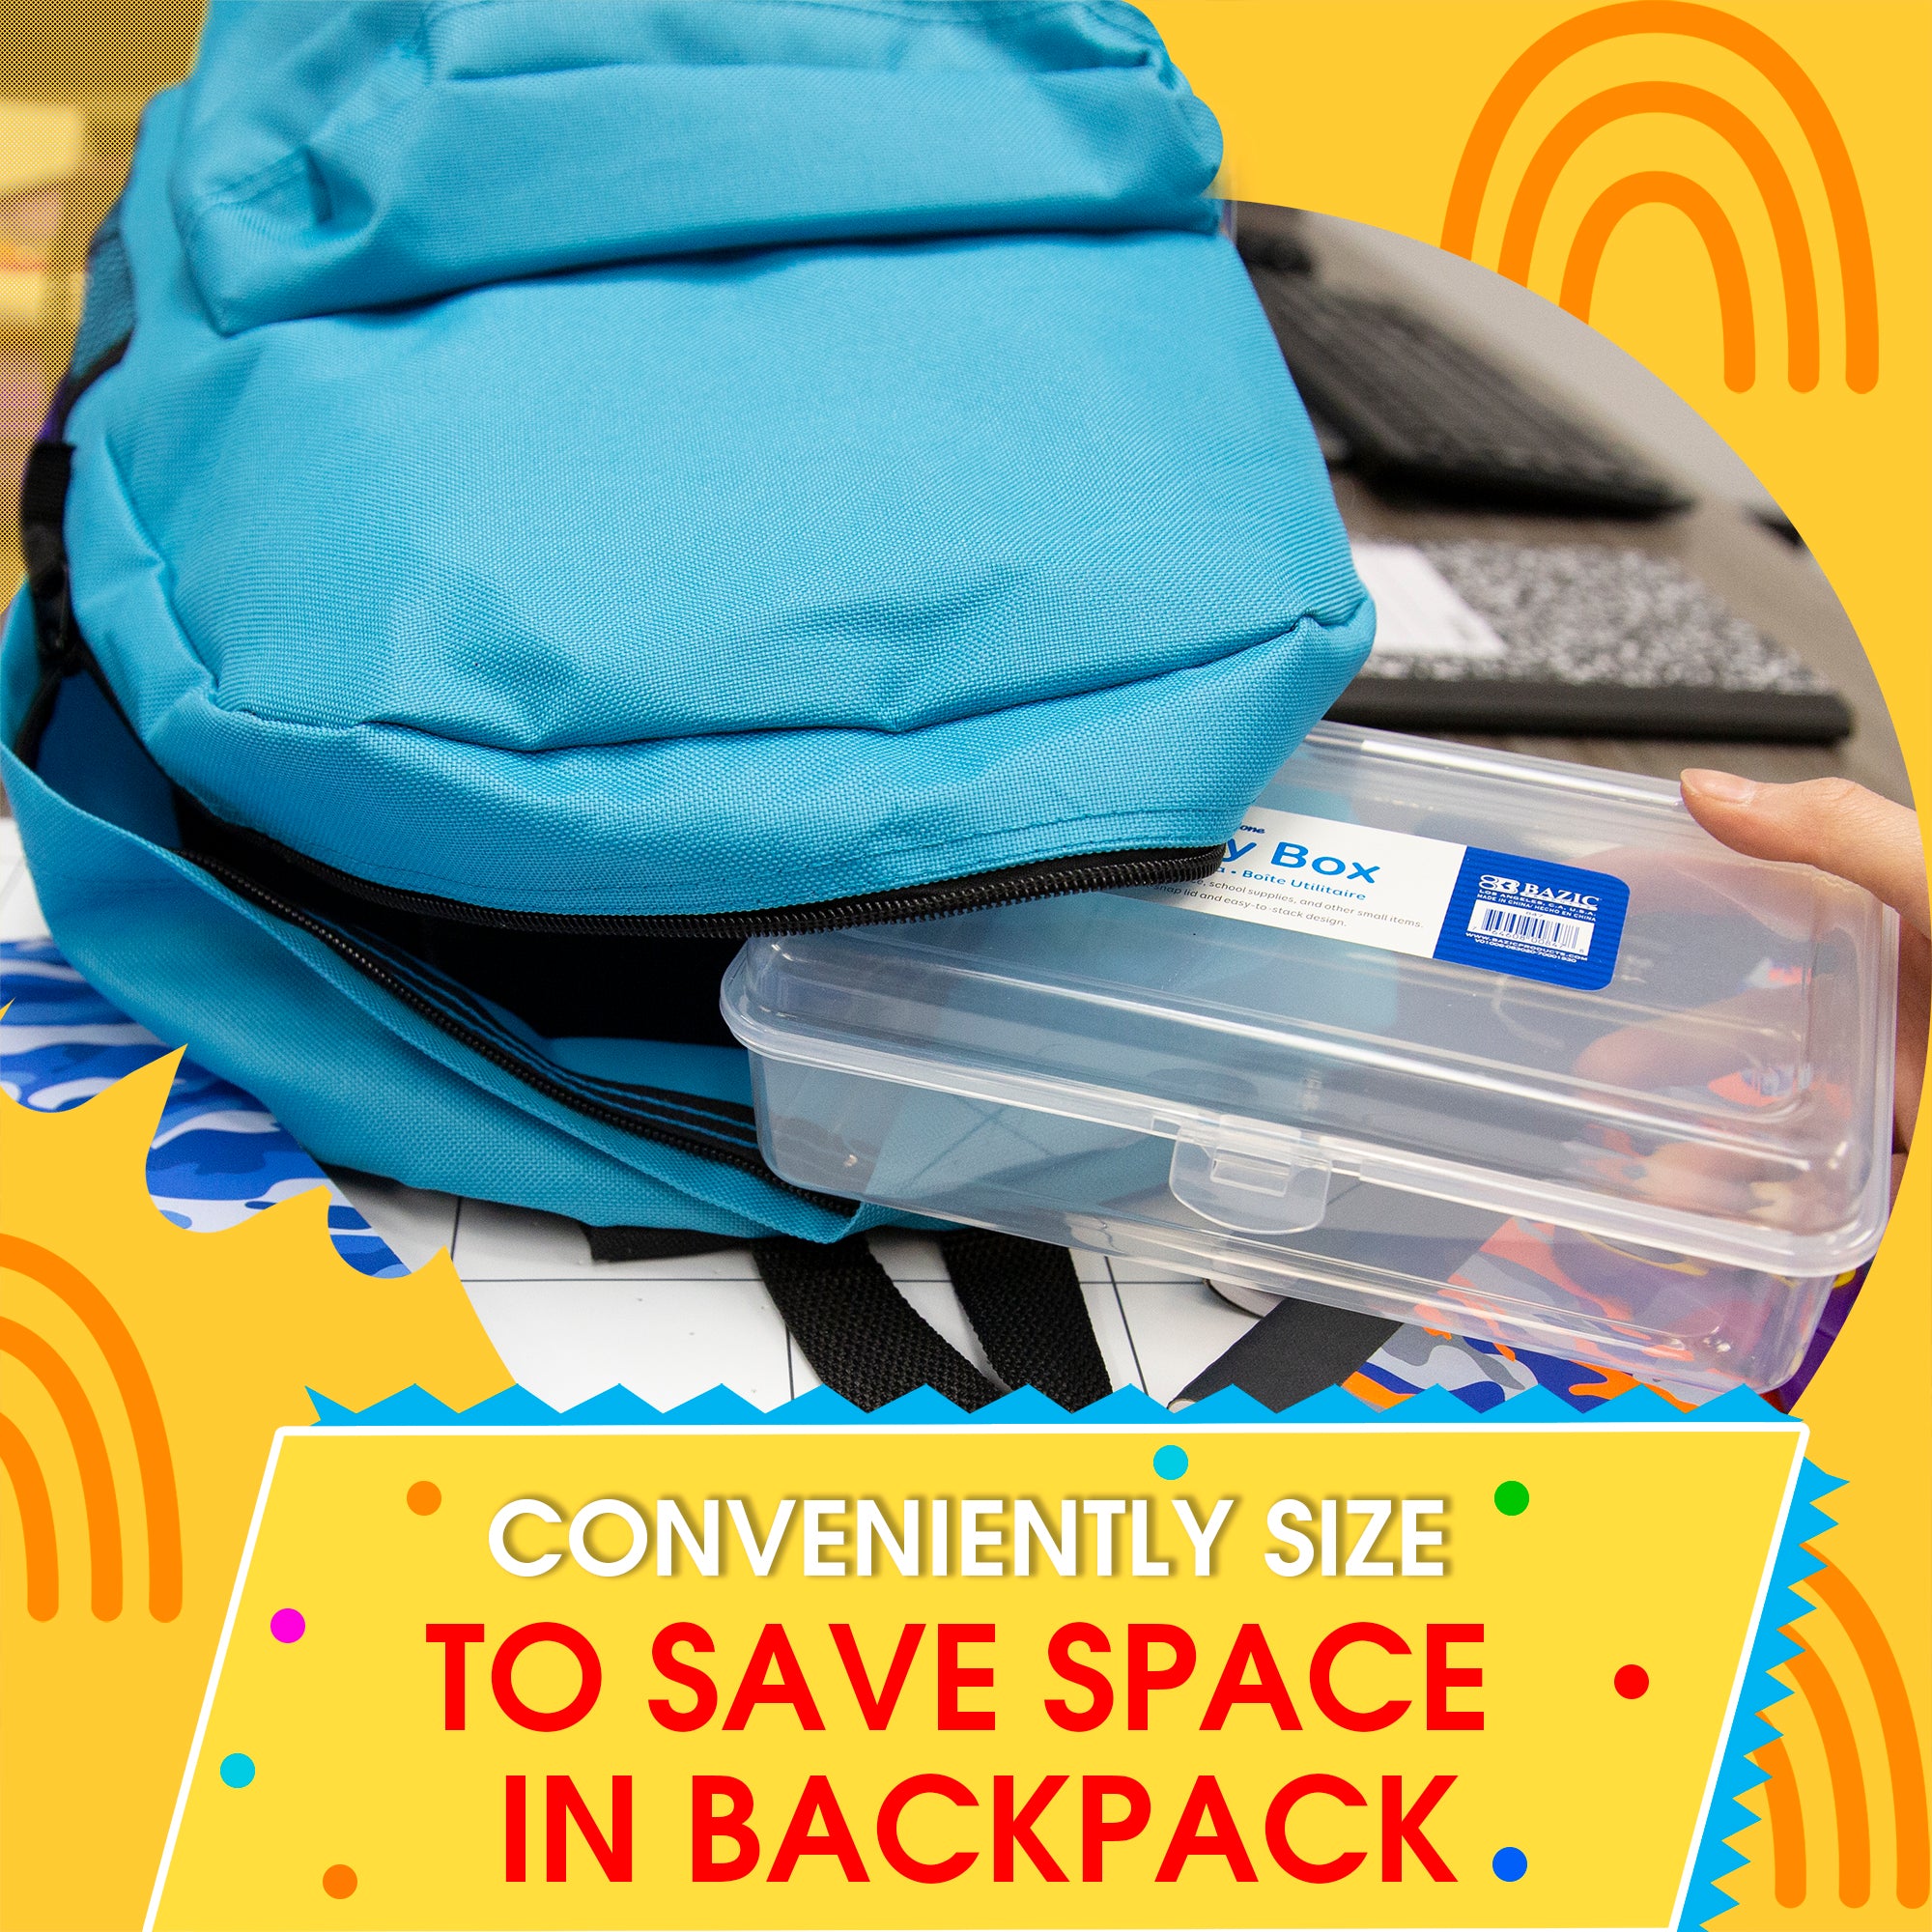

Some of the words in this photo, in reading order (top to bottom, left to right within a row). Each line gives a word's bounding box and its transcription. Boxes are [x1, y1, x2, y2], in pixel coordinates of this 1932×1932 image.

[1270, 841, 1380, 884] Box
[1242, 869, 1287, 885] Boîte
[1291, 879, 1367, 900] Utilitaire
[1523, 882, 1601, 907] BAZIC
[1183, 888, 1199, 897] lid
[1200, 893, 1223, 902] and
[1305, 912, 1348, 927] design.
[1208, 881, 1246, 894] school
[1248, 888, 1297, 904] supplies,
[1299, 897, 1323, 909] and
[1324, 901, 1355, 915] other
[1357, 909, 1389, 922] small
[1389, 915, 1424, 928] items.
[1534, 904, 1561, 914] HECHO
[1573, 912, 1597, 922] CHINA
